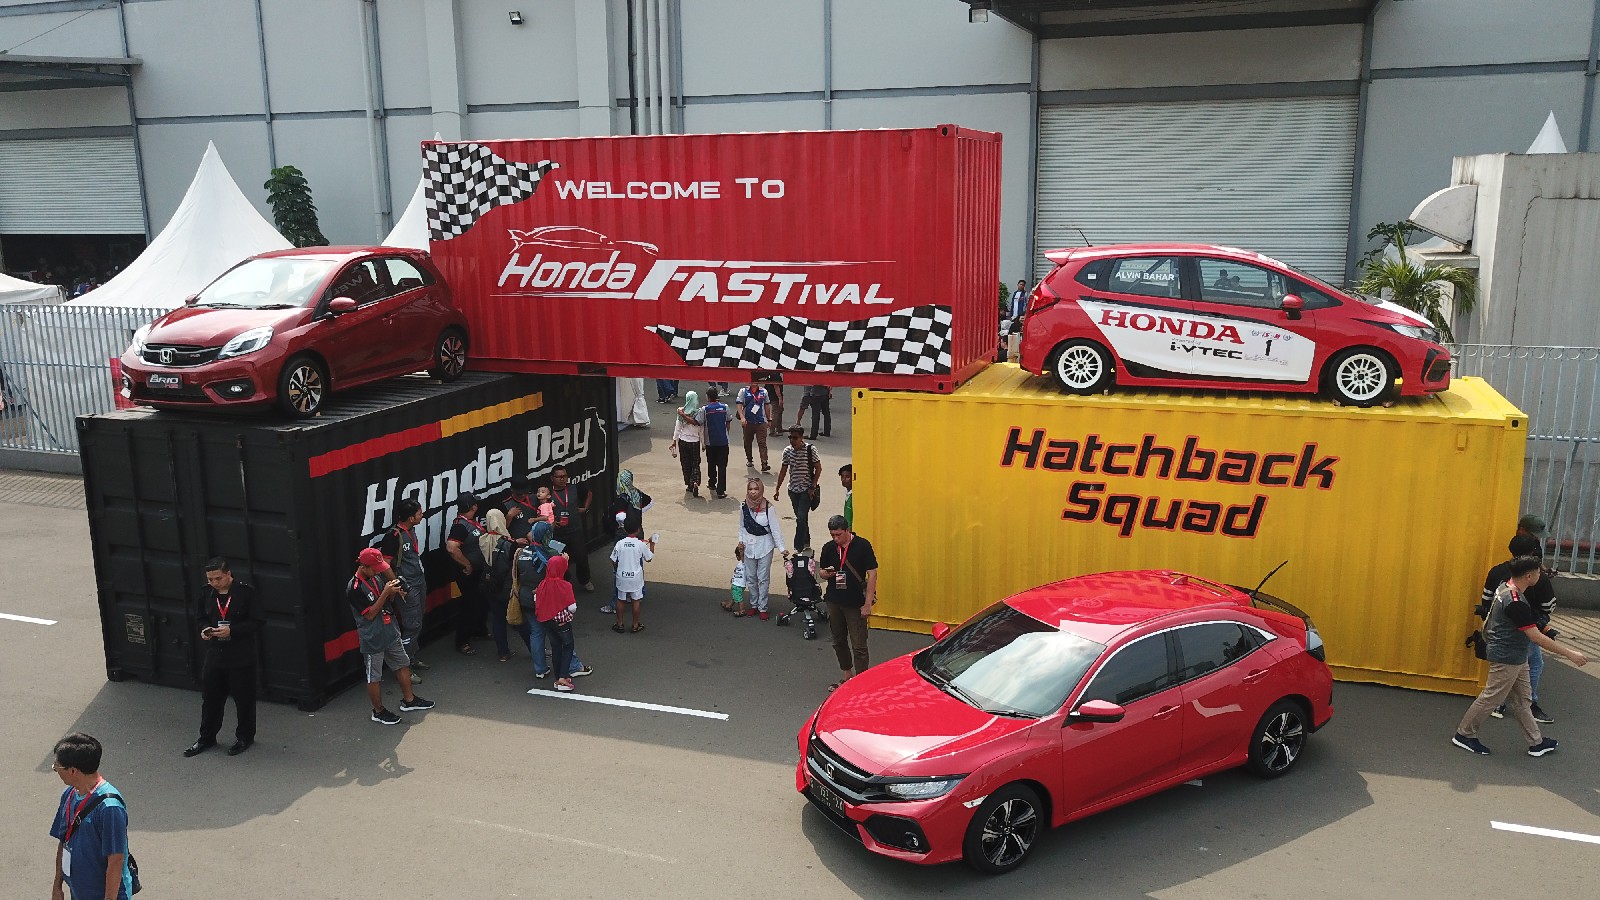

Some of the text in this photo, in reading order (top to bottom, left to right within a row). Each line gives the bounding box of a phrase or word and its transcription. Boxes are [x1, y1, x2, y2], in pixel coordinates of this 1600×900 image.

[554, 177, 785, 200] WELCOME TO
[497, 251, 636, 290] Honda
[1115, 271, 1175, 281] ALVIN BAHAR
[1098, 309, 1245, 345] HONDA
[1170, 341, 1243, 360] i-VTEC
[1264, 339, 1273, 356] 1
[1001, 427, 1341, 490] Hatchback
[361, 446, 514, 537] Honda
[527, 418, 592, 470] Day
[1062, 481, 1269, 538] Squad
